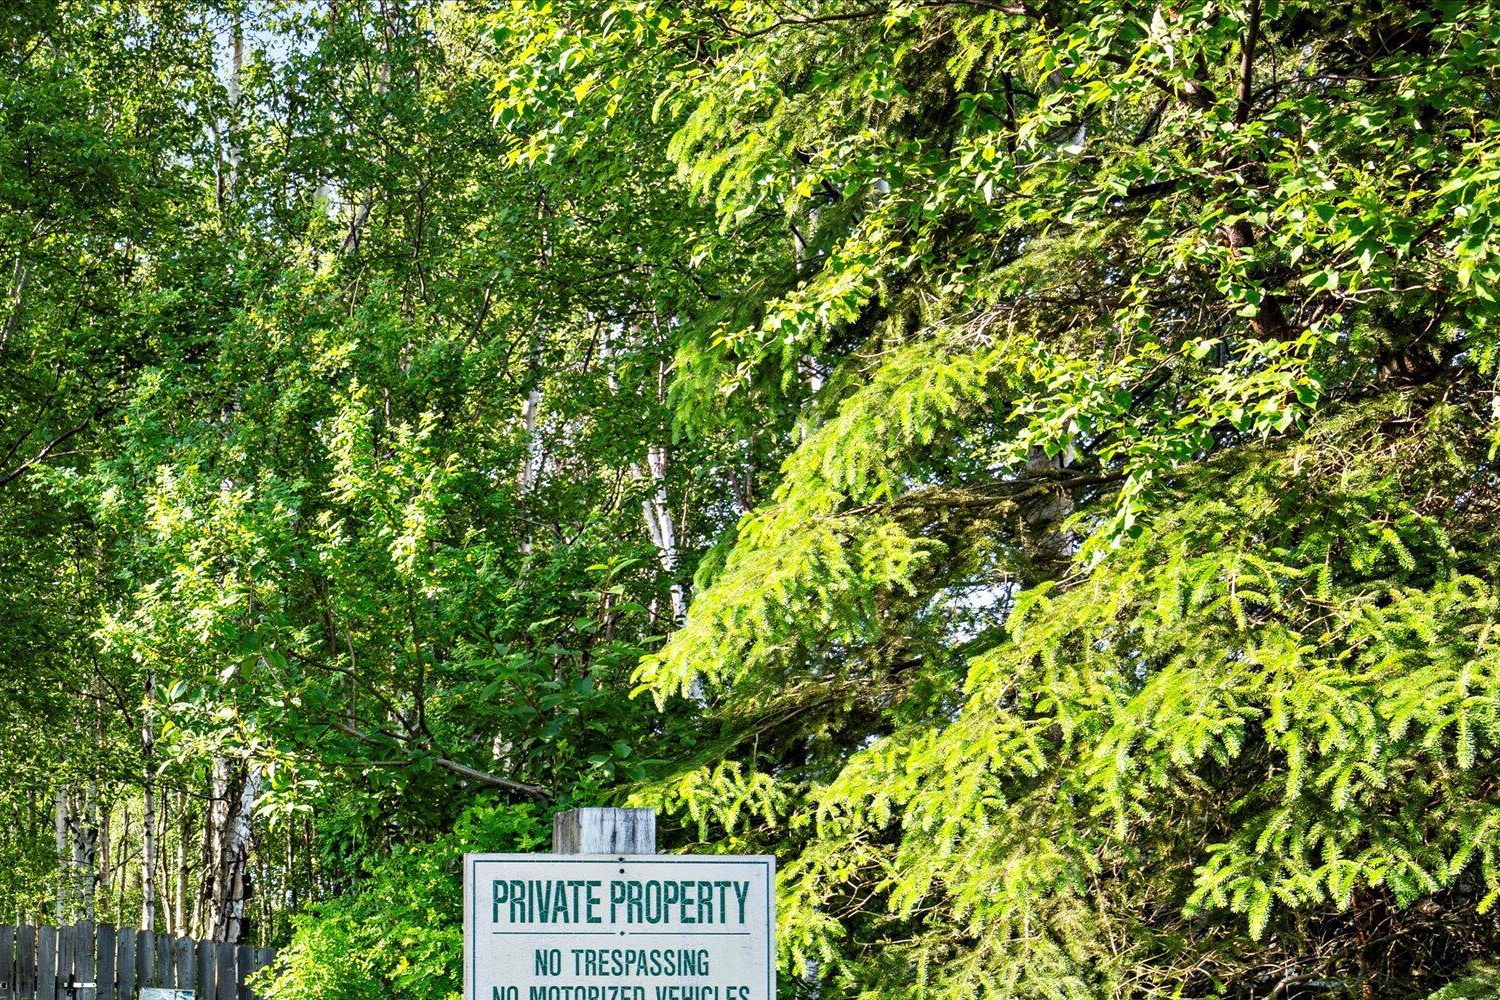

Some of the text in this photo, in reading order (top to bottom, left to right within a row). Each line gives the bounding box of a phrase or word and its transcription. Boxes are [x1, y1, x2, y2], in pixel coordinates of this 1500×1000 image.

[493, 880, 750, 925] PRIVATE PROPERTY
[535, 949, 709, 977] NO TRESPASSING
